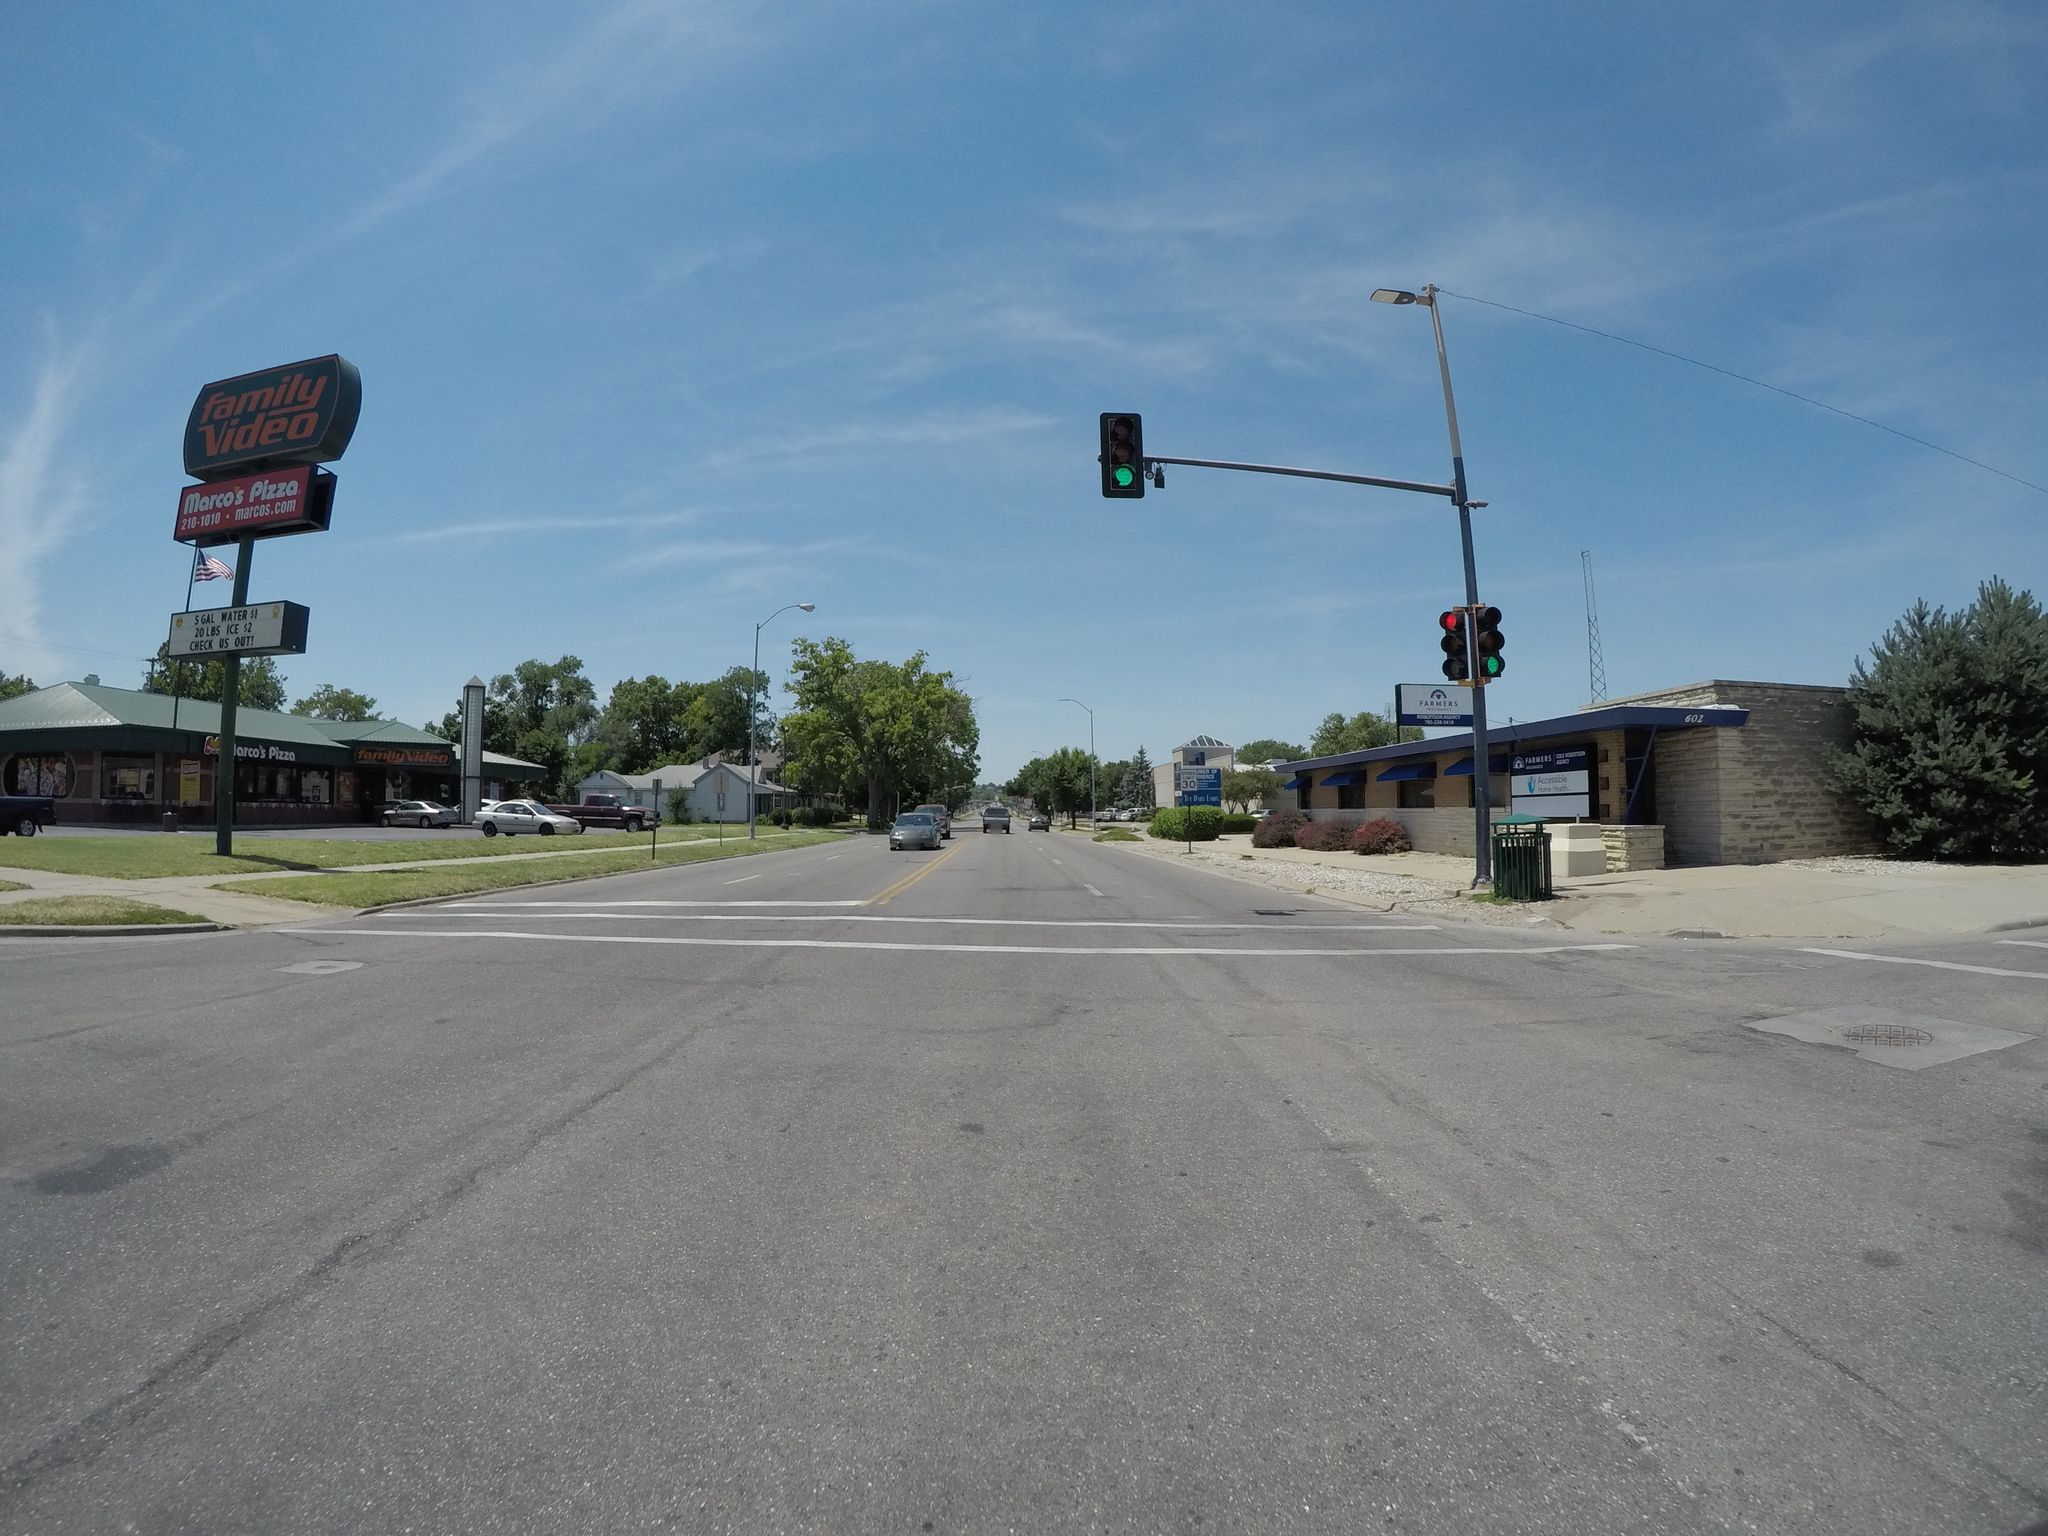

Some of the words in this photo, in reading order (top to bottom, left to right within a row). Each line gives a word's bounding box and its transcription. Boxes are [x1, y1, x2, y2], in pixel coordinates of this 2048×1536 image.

[201, 373, 328, 424] family
[198, 411, 319, 457] Video
[183, 487, 245, 515] Marco's
[249, 480, 299, 502] Pizza
[181, 512, 221, 531] 210-1010
[235, 499, 296, 520] marcos.com
[221, 610, 248, 623] WATER
[226, 623, 240, 635] ICE
[243, 622, 253, 633] $2
[189, 639, 214, 651] CHECK
[219, 638, 229, 649] US
[234, 635, 255, 647] OUT!
[1684, 714, 1704, 723] 602
[233, 743, 266, 759] arco's
[268, 746, 296, 762] Pizza
[404, 751, 449, 763] Video
[1525, 754, 1552, 764] FARMERS
[1182, 780, 1196, 789] 30
